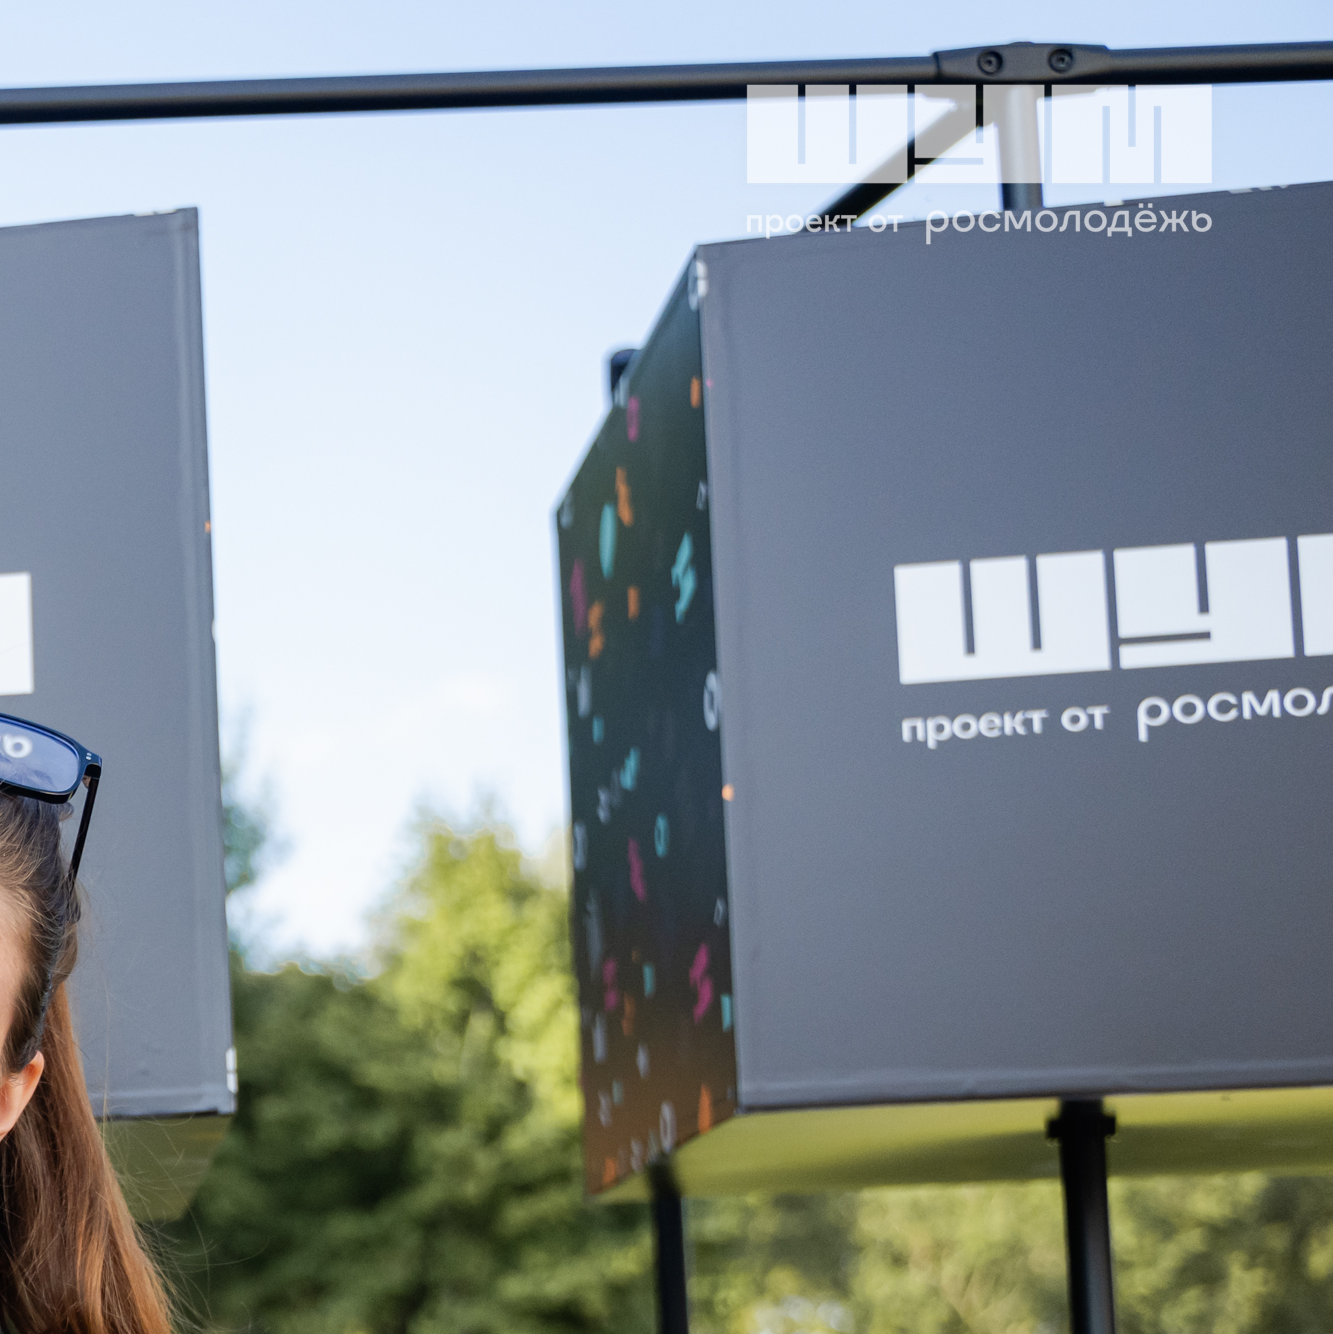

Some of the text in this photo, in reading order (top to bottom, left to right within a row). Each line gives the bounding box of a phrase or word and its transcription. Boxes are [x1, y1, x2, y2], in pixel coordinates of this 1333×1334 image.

[893, 532, 1333, 685] ШУ
[901, 708, 1049, 749] проект
[1060, 704, 1110, 733] от
